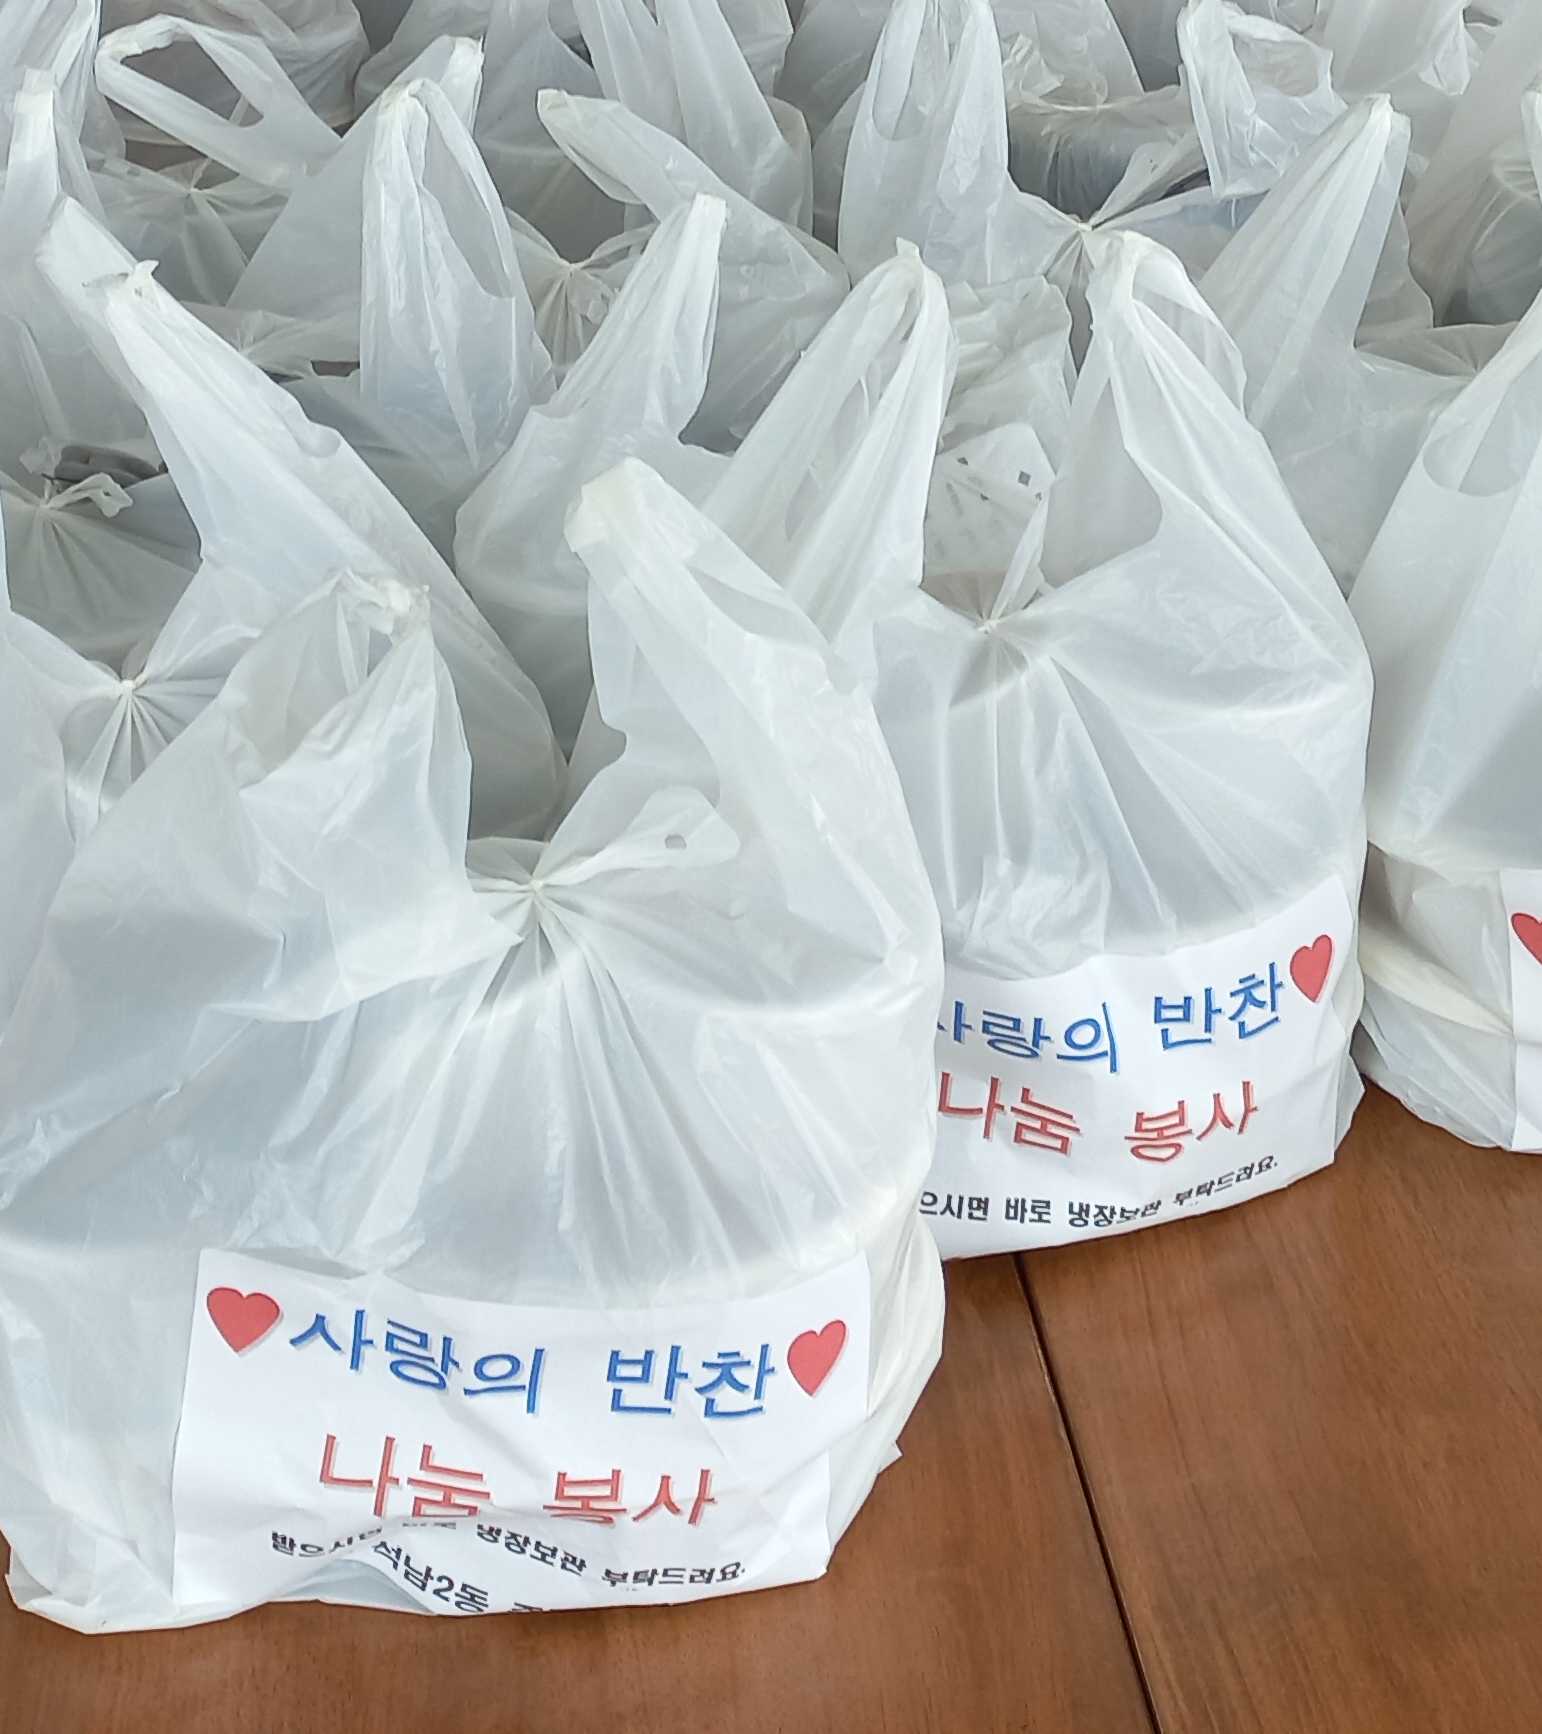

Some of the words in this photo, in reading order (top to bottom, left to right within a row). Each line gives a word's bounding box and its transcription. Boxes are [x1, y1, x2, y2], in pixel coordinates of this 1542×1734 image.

[1153, 961, 1285, 1051] 반찬
[937, 1070, 1082, 1156] 나눔
[1123, 1079, 1260, 1164] 봉사
[1004, 1197, 1052, 1226] 바로
[288, 1308, 546, 1415] 사랑의
[605, 1343, 779, 1420] 반찬
[317, 1432, 495, 1519] 나눔
[542, 1466, 720, 1527] 봉사
[373, 1540, 490, 1614] 석남2동
[476, 1523, 588, 1577] 냉장보관
